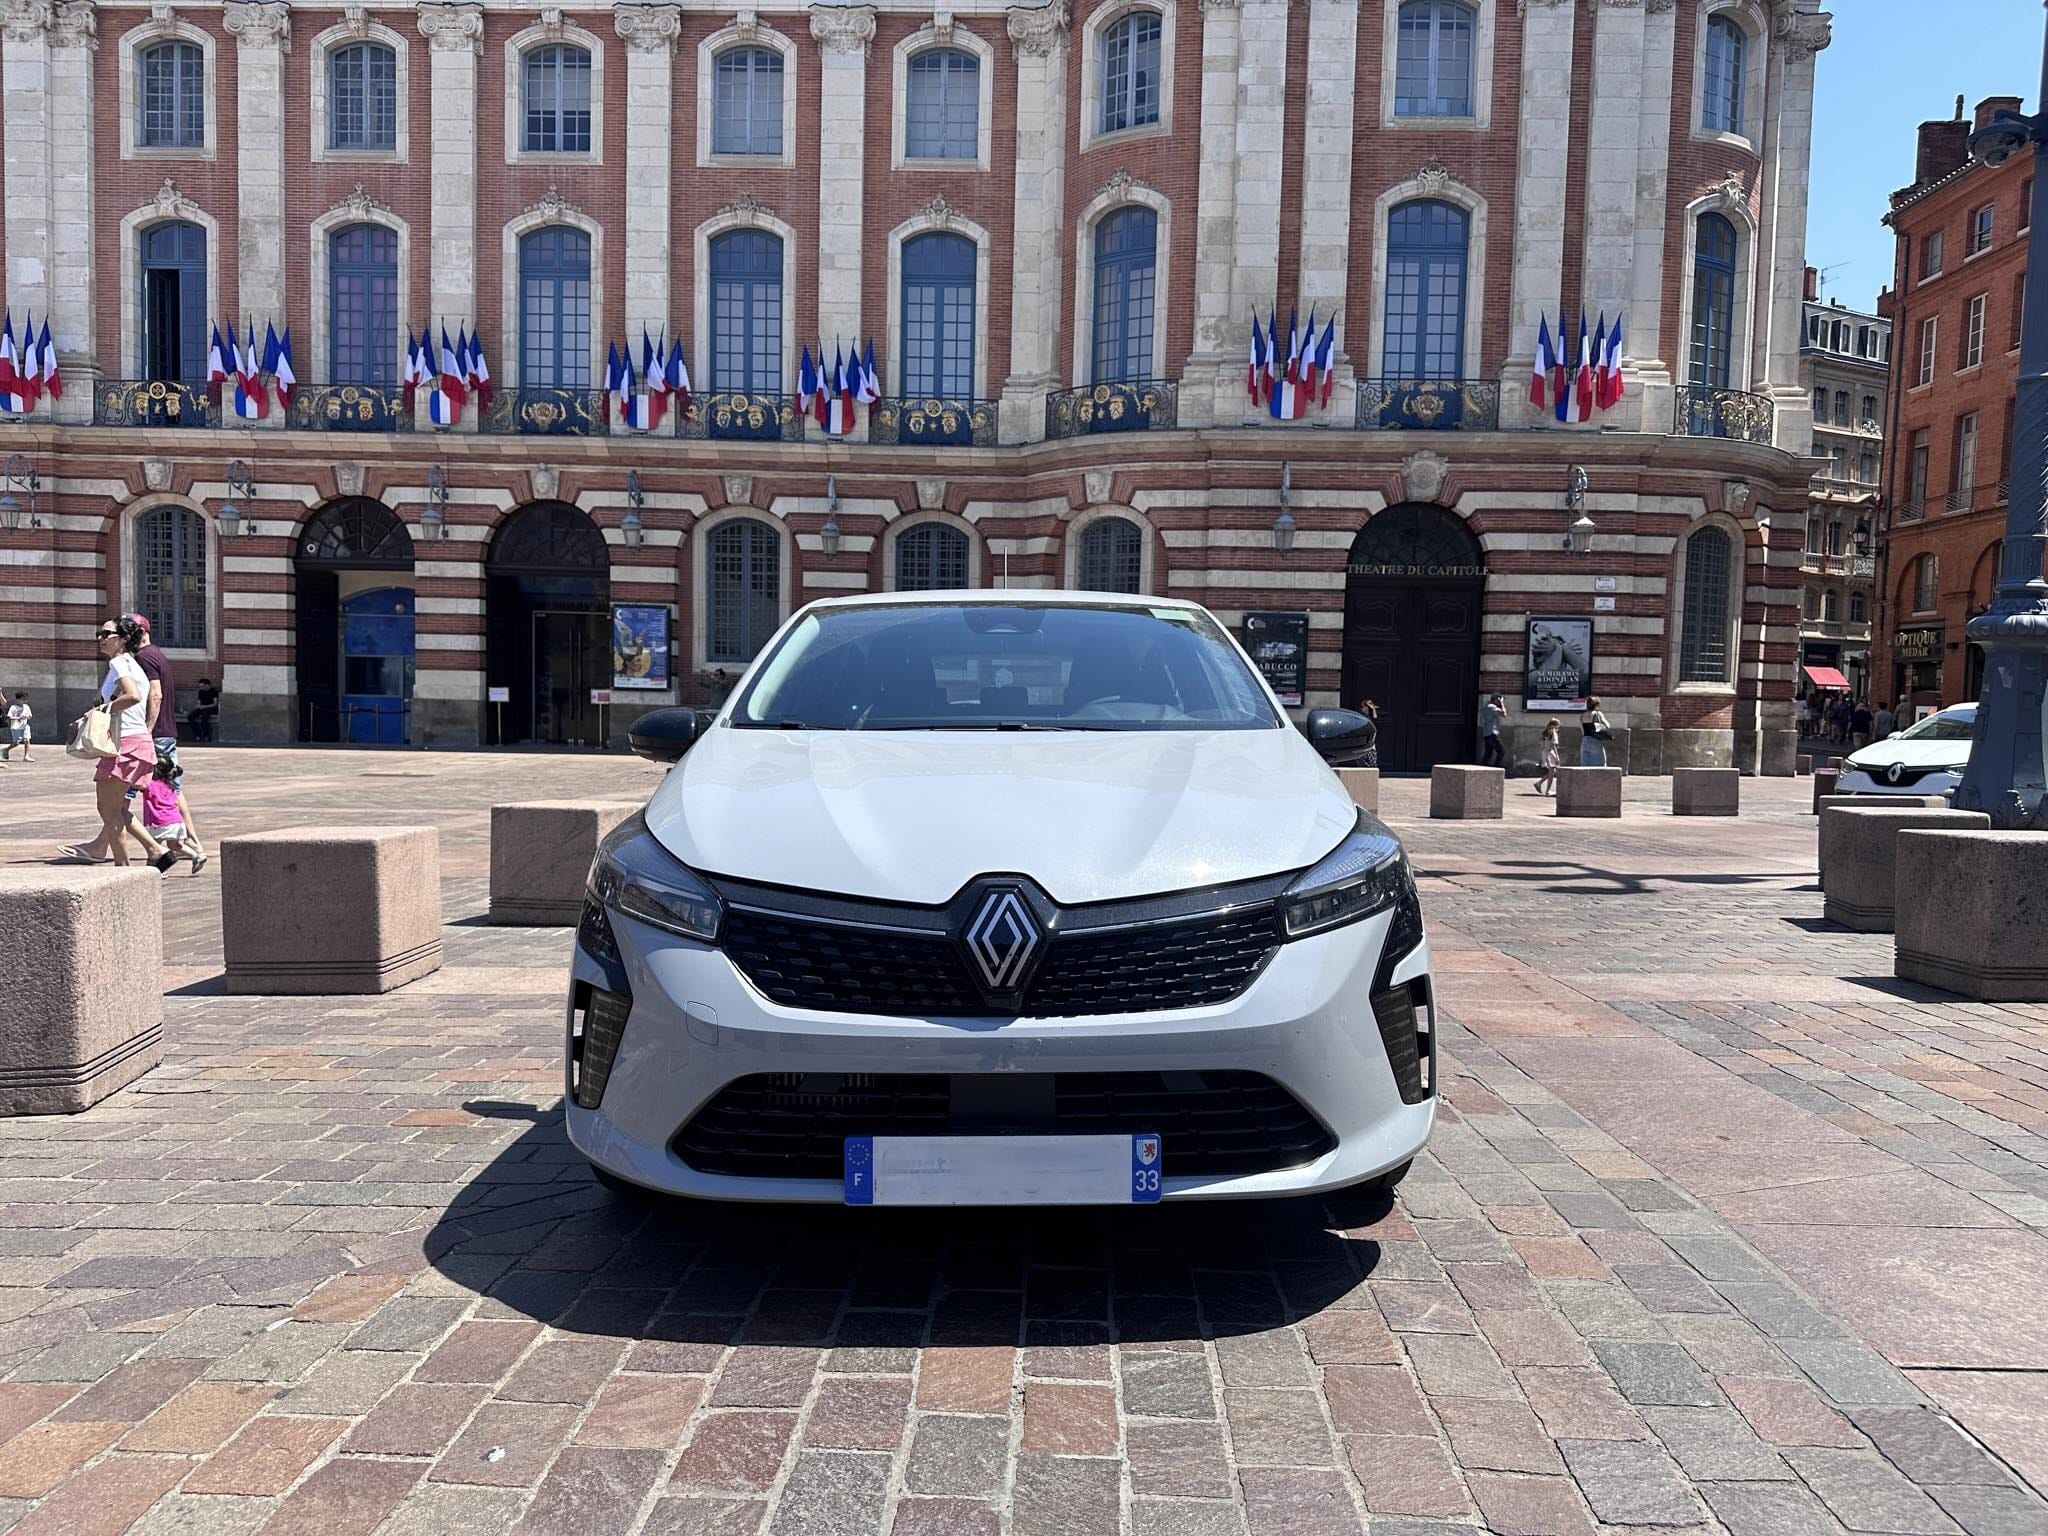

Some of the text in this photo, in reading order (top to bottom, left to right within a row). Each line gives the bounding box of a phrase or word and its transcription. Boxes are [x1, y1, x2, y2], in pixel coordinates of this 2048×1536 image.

[1347, 564, 1491, 576] THEATRE DU CAPITOLE
[1895, 632, 1936, 647] OPTIQUE
[1257, 663, 1297, 671] ABUCCO
[854, 1173, 863, 1186] F
[1135, 1170, 1159, 1192] 33
